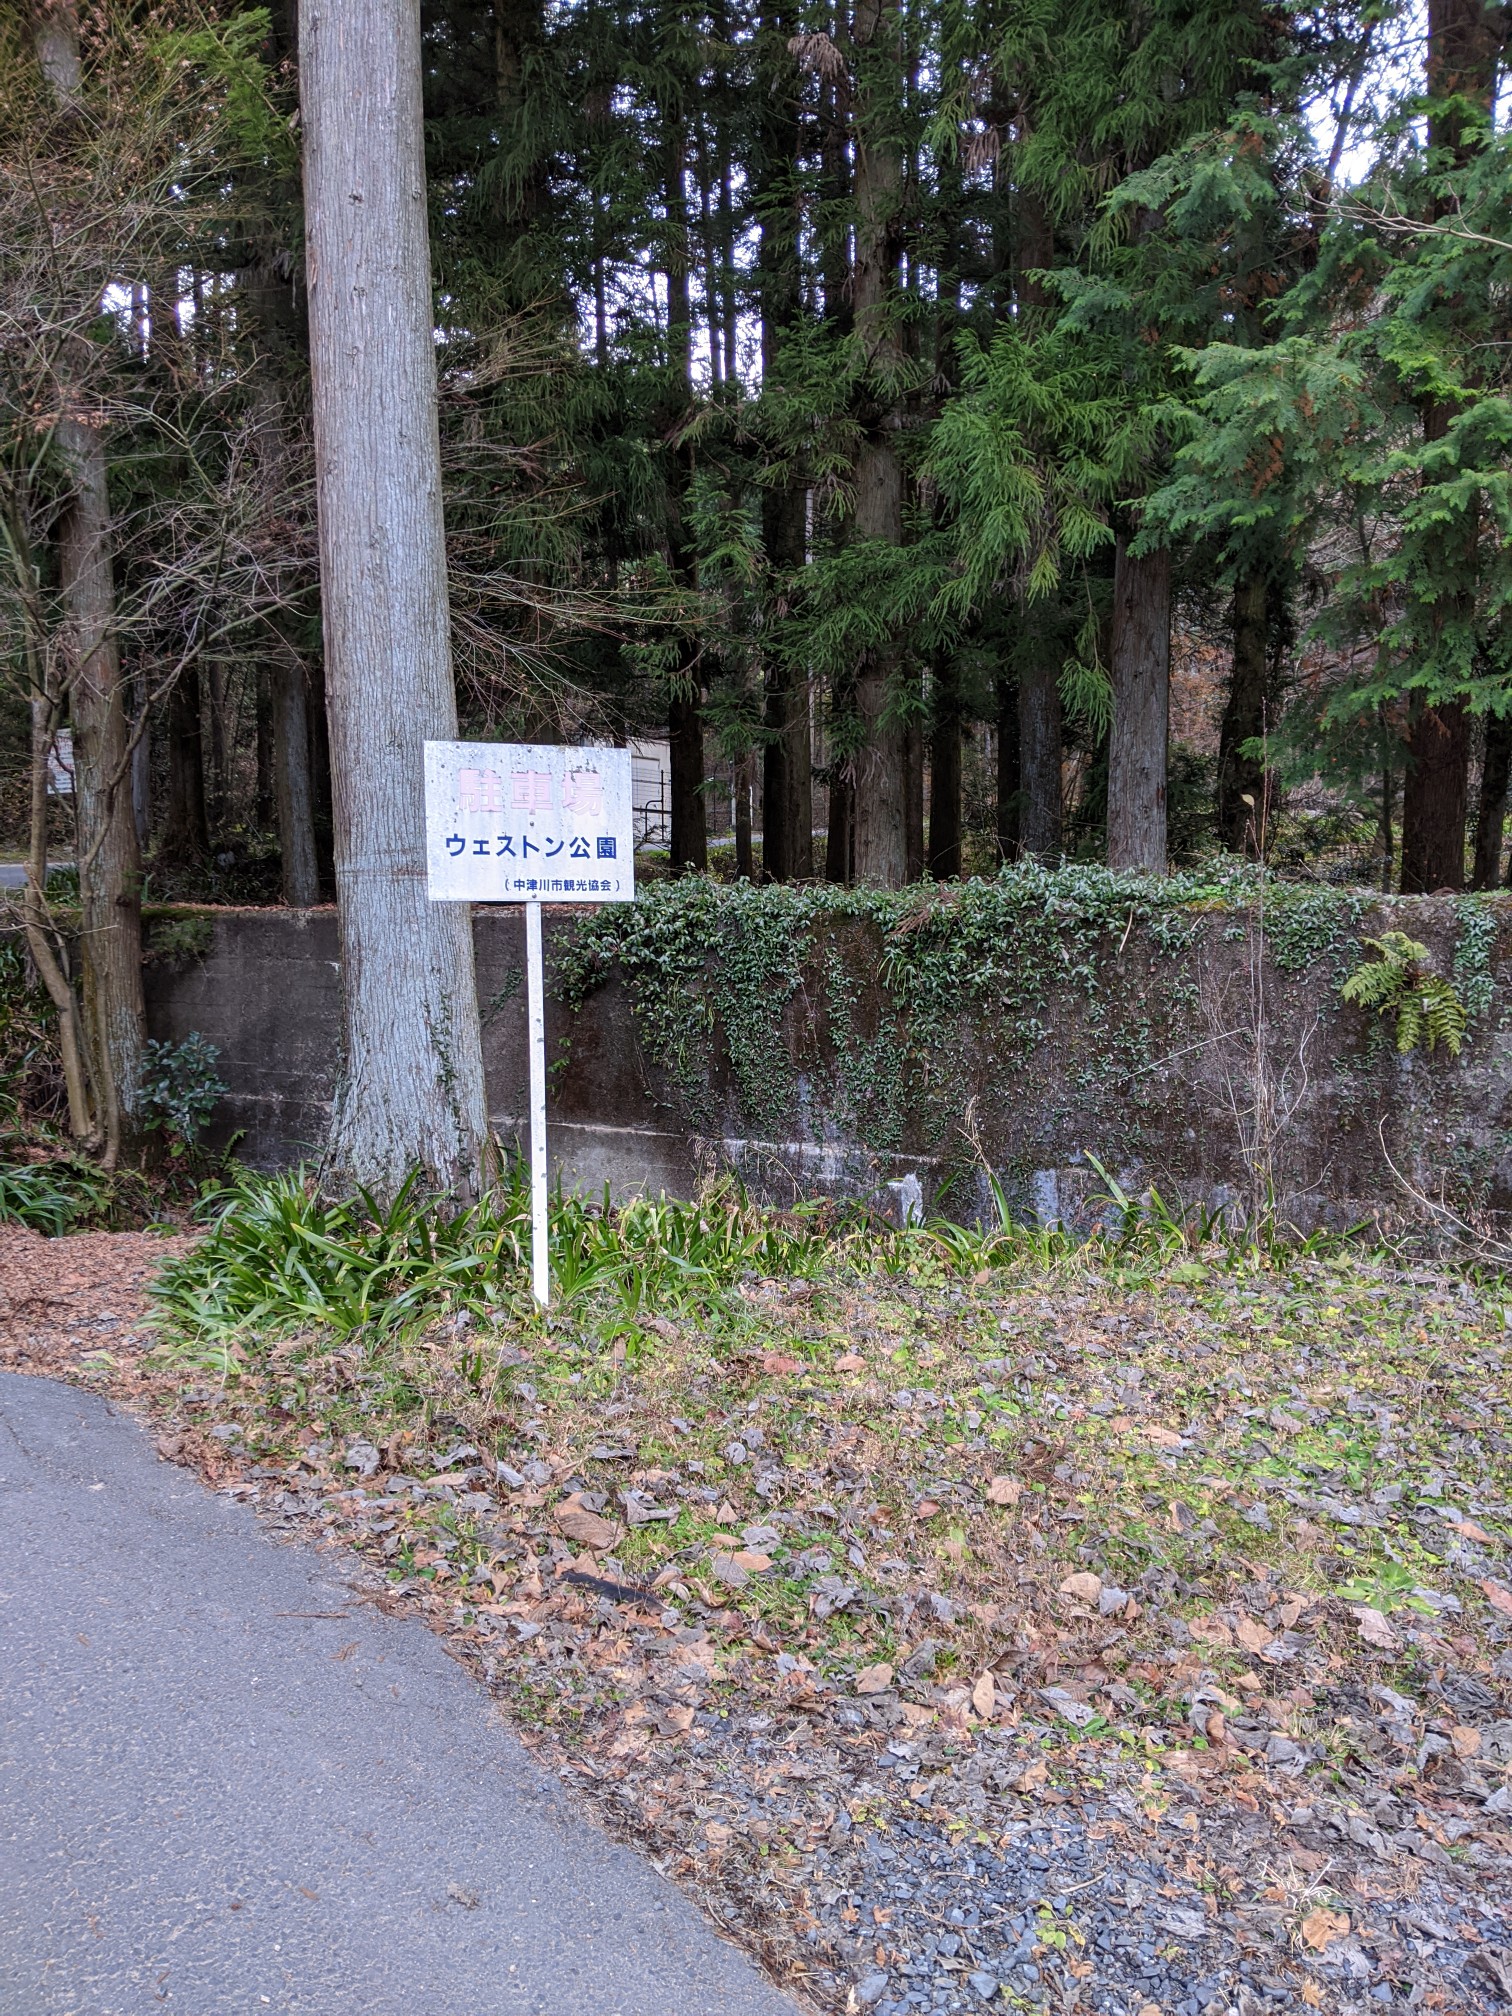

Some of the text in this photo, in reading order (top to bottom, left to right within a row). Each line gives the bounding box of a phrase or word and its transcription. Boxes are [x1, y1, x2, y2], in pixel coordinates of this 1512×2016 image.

[459, 768, 604, 816] 駐車場
[446, 833, 617, 859] ウェストン公園
